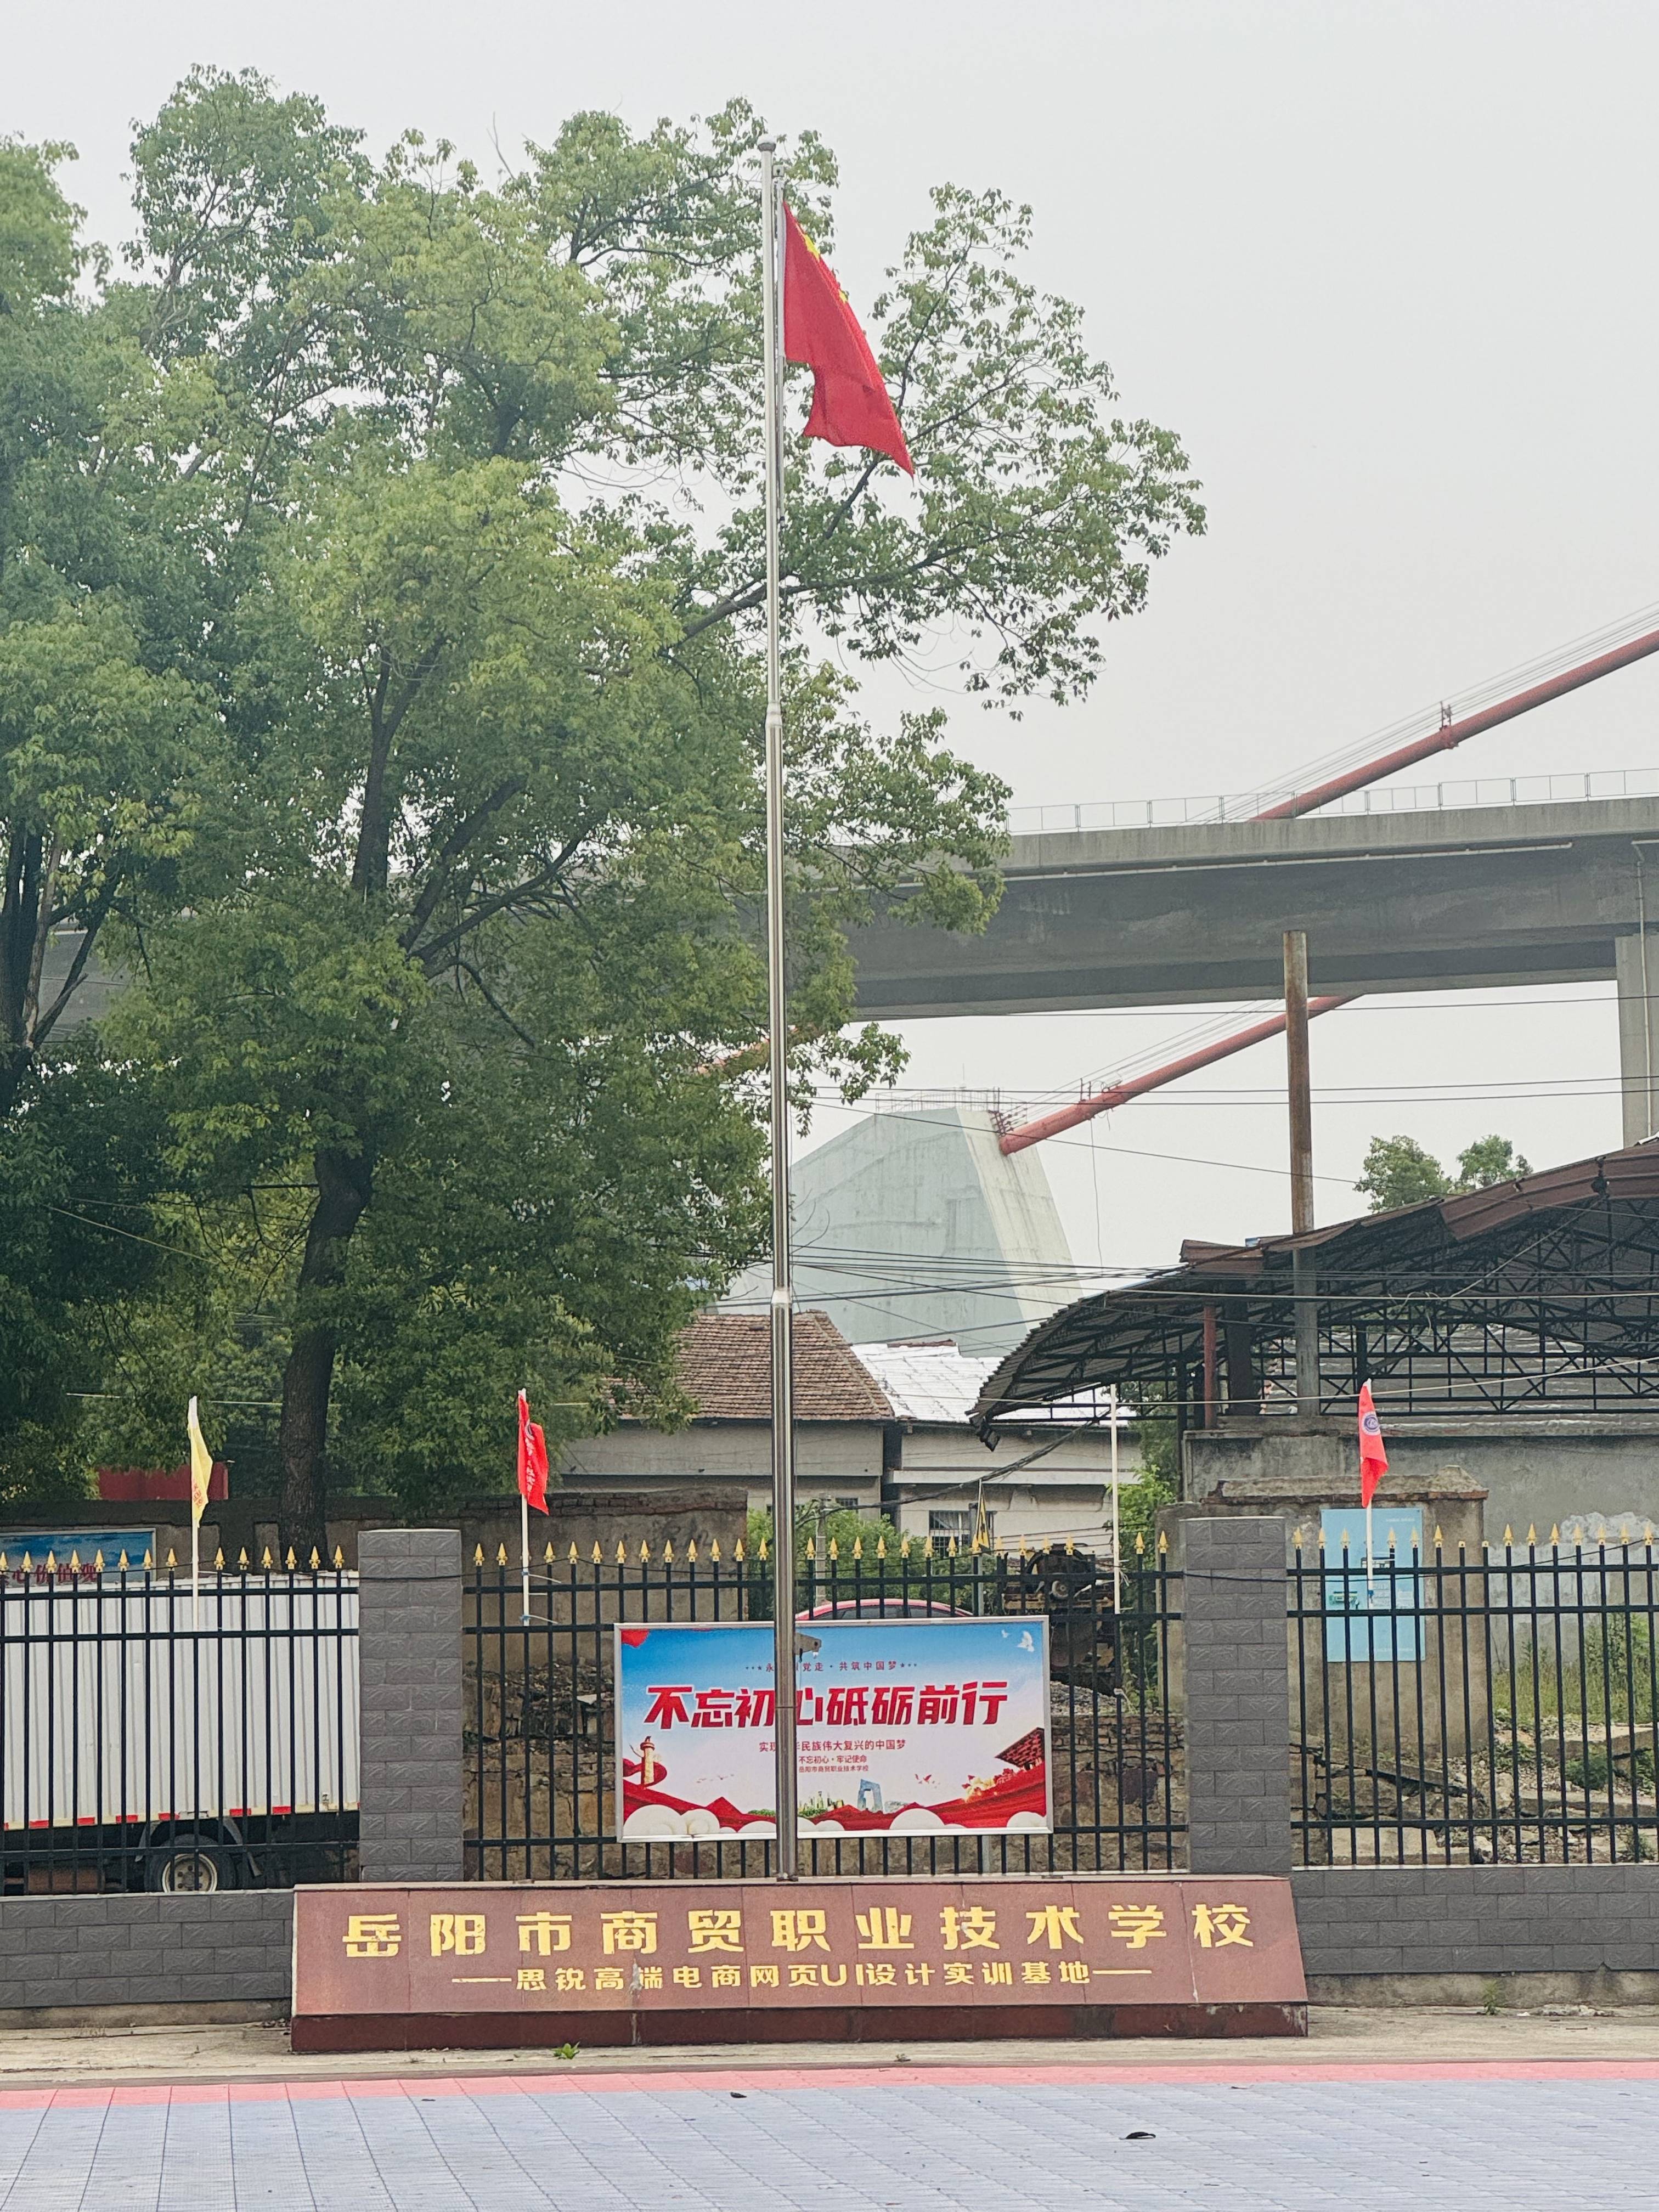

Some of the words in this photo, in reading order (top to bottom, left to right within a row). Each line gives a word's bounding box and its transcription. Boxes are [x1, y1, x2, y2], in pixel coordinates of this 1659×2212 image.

[765, 1661, 896, 1672] 永党走·共筑中国梦
[644, 1681, 1008, 1730] 不忘初心砥砺前行
[759, 1739, 906, 1752] 实现民族伟大复兴的中国梦
[343, 1903, 1254, 1958] 岳阳市商贸职业技术学校
